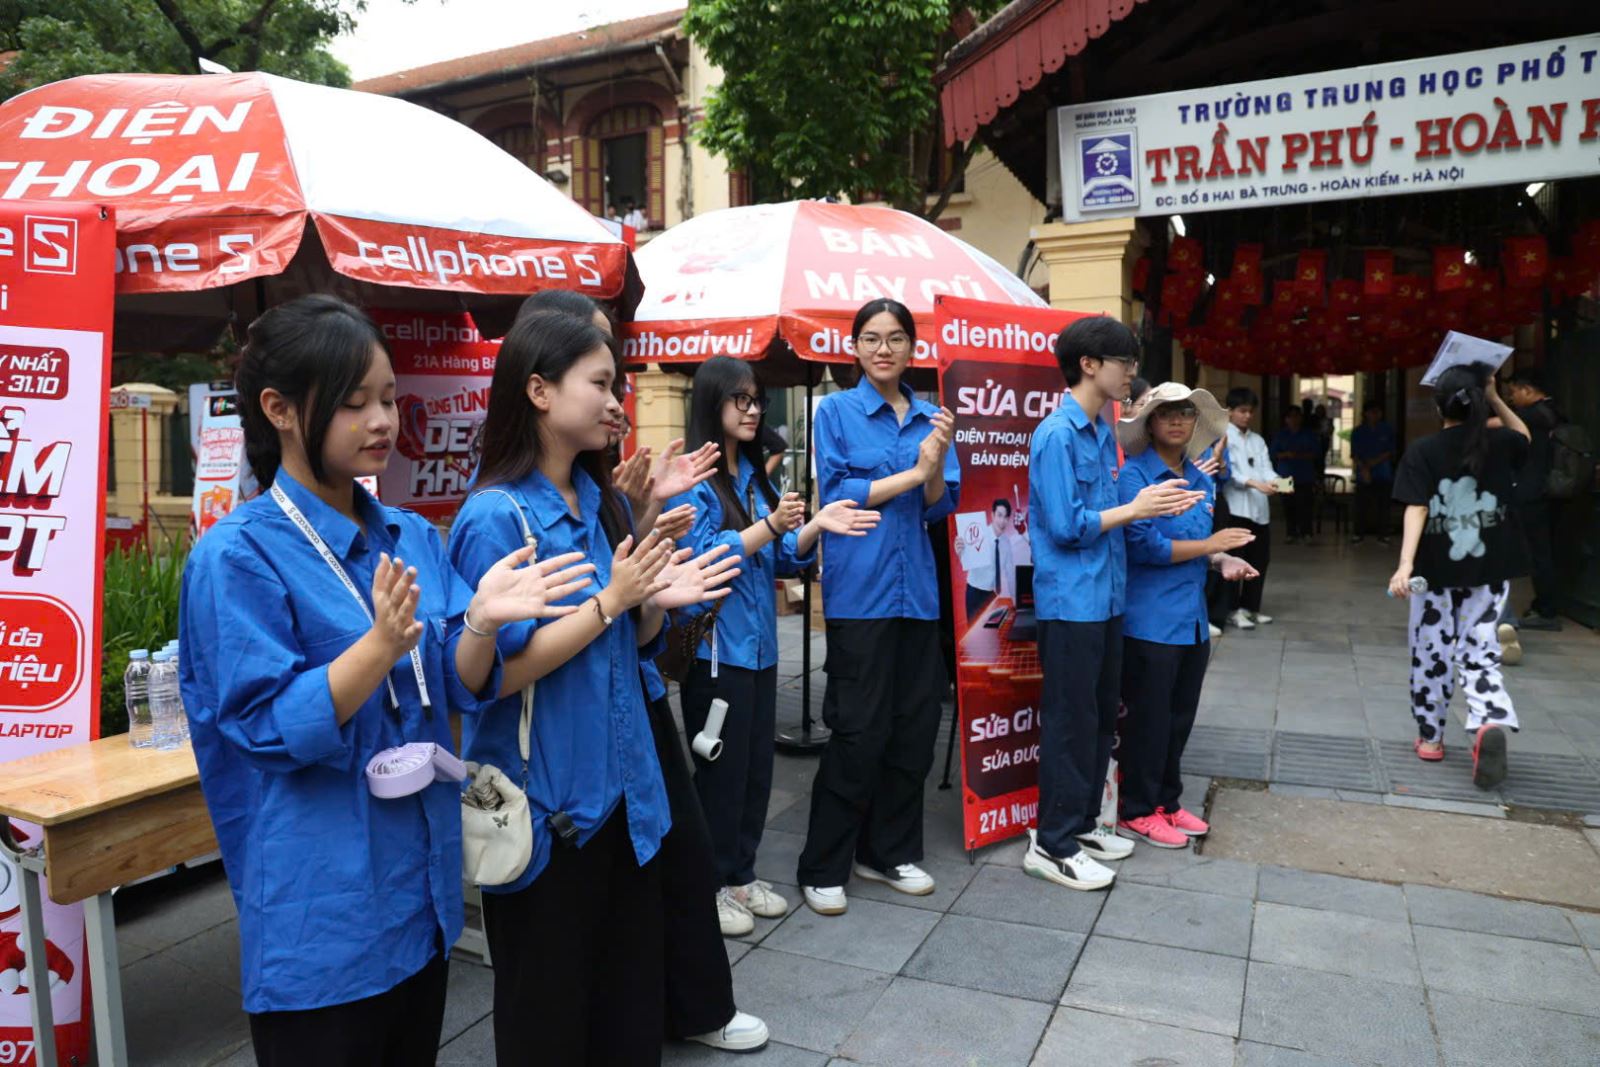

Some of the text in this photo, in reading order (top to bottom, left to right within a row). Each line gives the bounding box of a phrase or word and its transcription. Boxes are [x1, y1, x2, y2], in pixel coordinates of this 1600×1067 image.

[1178, 92, 1293, 125] TRƯỜNG
[1304, 76, 1406, 109] TRUNG
[1418, 66, 1484, 96] HỌC
[20, 101, 253, 145] ĐIỆN
[1146, 122, 1270, 184] TRẦN
[1282, 111, 1378, 170] PHÚ
[1415, 97, 1568, 159] HOÀN
[0, 152, 260, 202] HOẠI
[1202, 191, 1210, 203] 8
[1212, 189, 1236, 202] HAI
[1239, 184, 1258, 199] BÀ
[1261, 181, 1309, 197] TRƯNG
[1320, 173, 1361, 192] HOÀN
[1365, 170, 1400, 187] KIẾM
[1413, 168, 1434, 184] HÀ
[1438, 166, 1465, 182] NỘI
[818, 225, 934, 259] BÁN
[802, 267, 908, 302] MÁY
[382, 318, 480, 347] cellpho
[9, 350, 62, 373] NHẤT
[413, 355, 439, 369] 21A
[442, 354, 480, 373] Hàng
[8, 374, 60, 395] 31.10
[452, 386, 493, 413] TÙN
[956, 379, 1065, 418] SỬA CH
[955, 427, 1027, 448] ĐIỆN THOẠI
[1000, 450, 1030, 469] ĐIỆN
[411, 459, 471, 495] KH
[8, 626, 44, 648] đa
[0, 722, 74, 739] LAPTOP
[969, 712, 1009, 743] Sửa
[981, 748, 1011, 773] SỬA
[979, 802, 1041, 834] 274 Ngu
